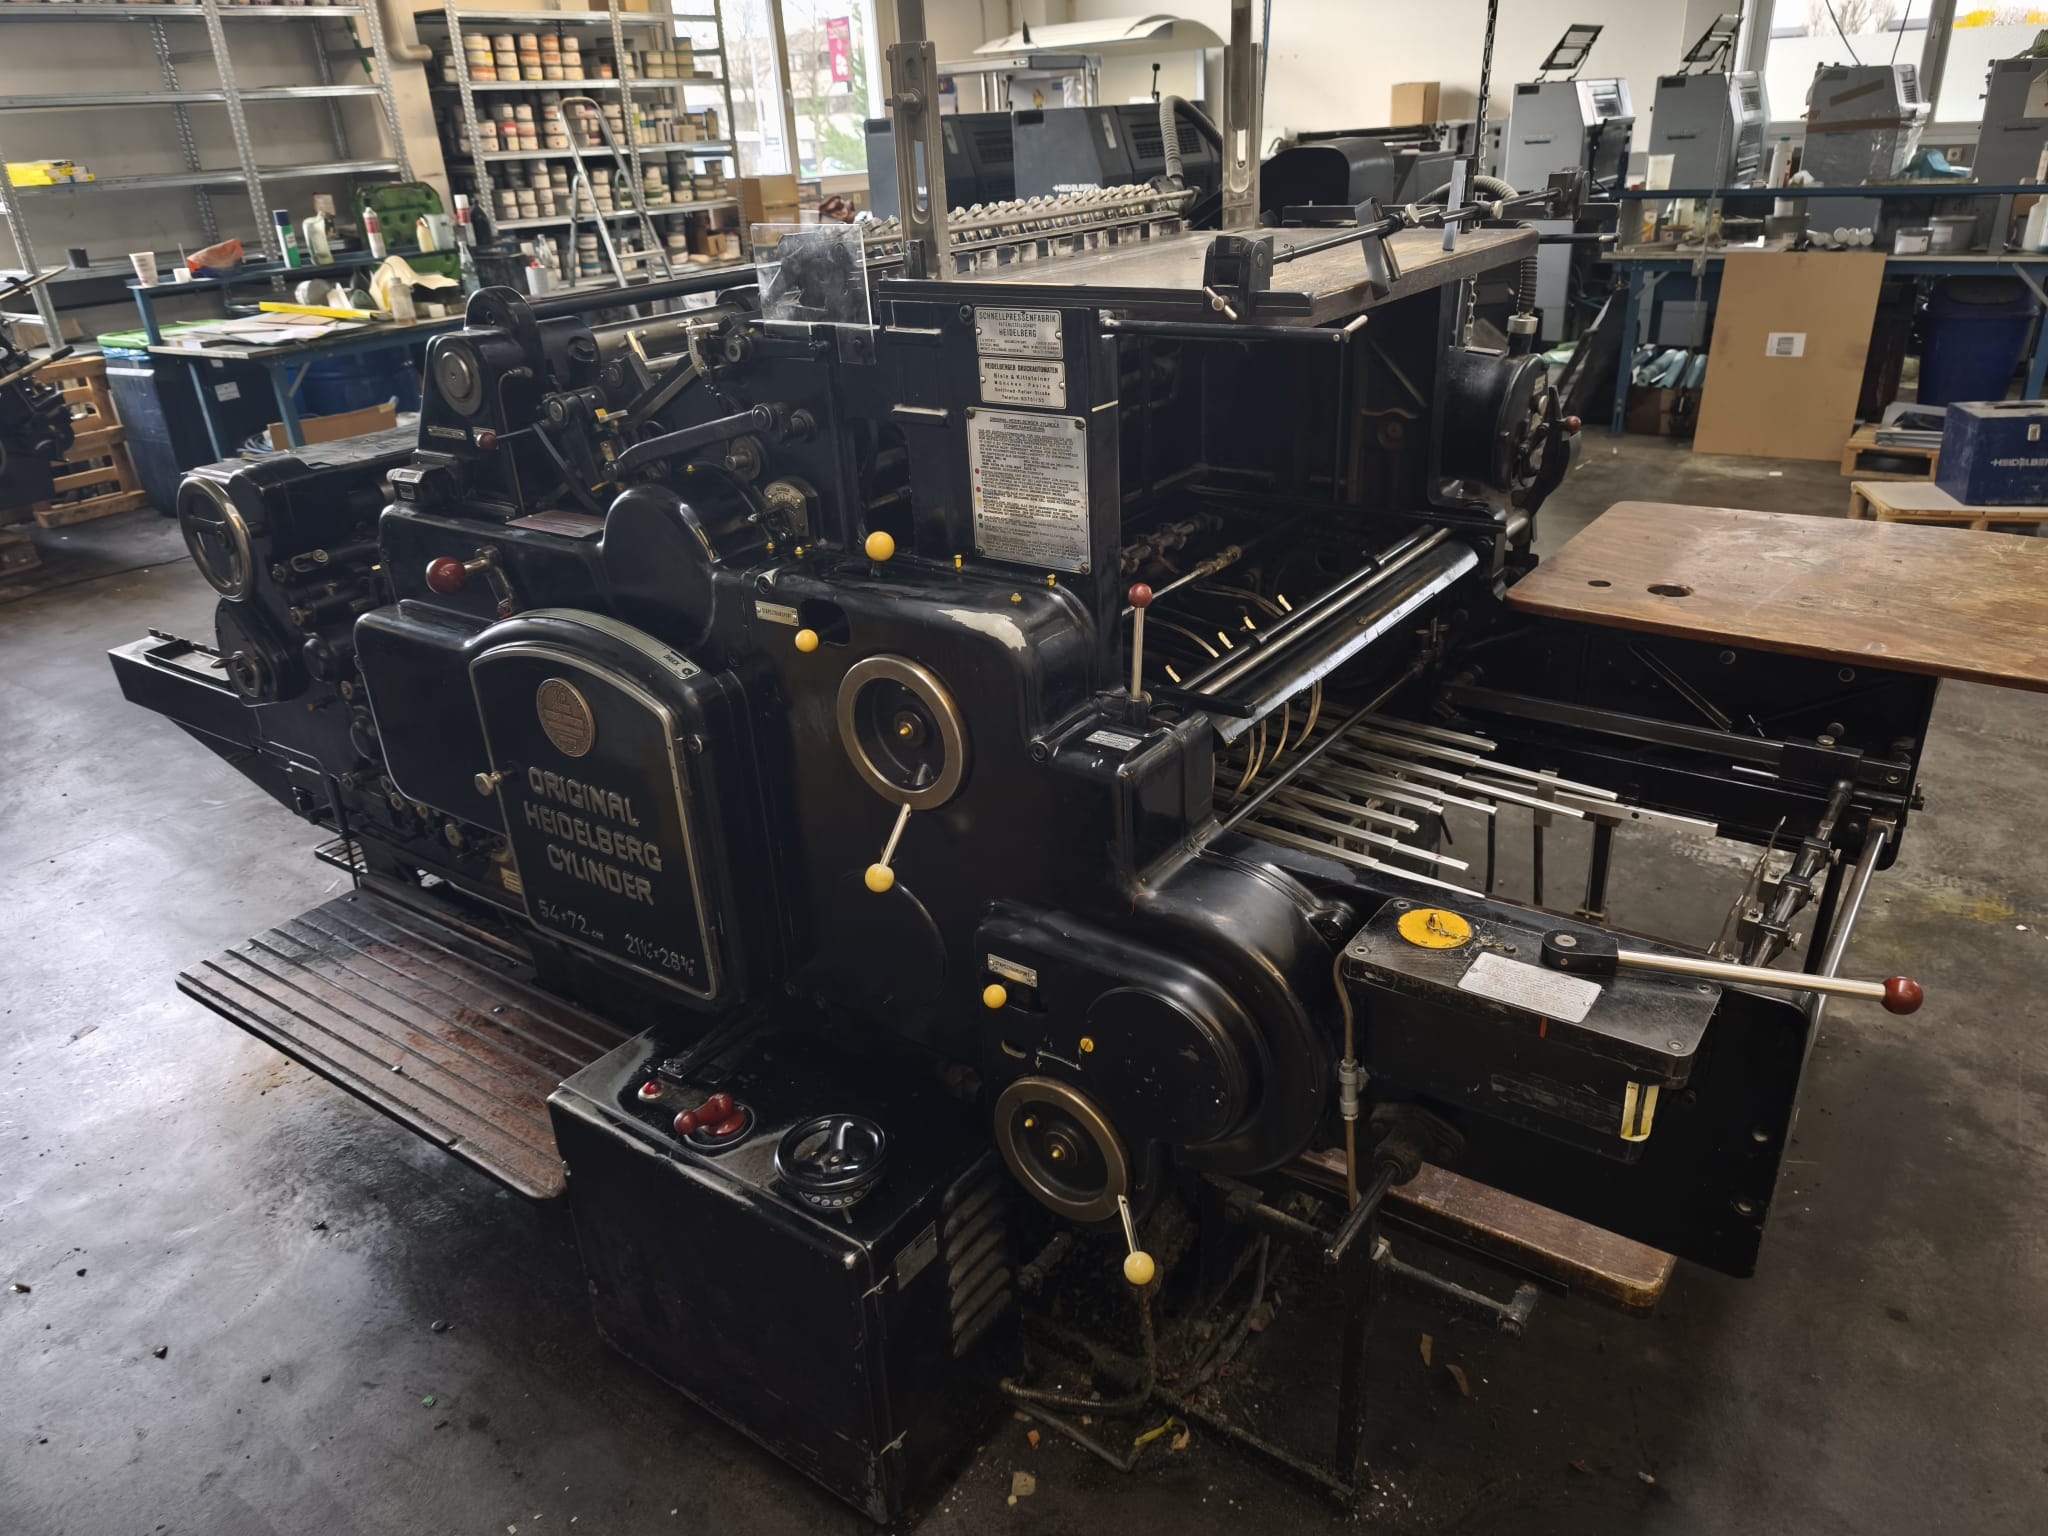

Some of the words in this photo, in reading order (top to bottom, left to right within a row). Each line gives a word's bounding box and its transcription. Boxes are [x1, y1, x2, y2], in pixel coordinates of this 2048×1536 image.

[979, 312, 1056, 323] SCHNELLPRESSENFABRIK
[998, 329, 1037, 338] HEIDELBERG
[528, 766, 640, 828] ORIGINAL
[524, 800, 662, 873] HEIDELBERG
[547, 843, 655, 906] CYLINDER
